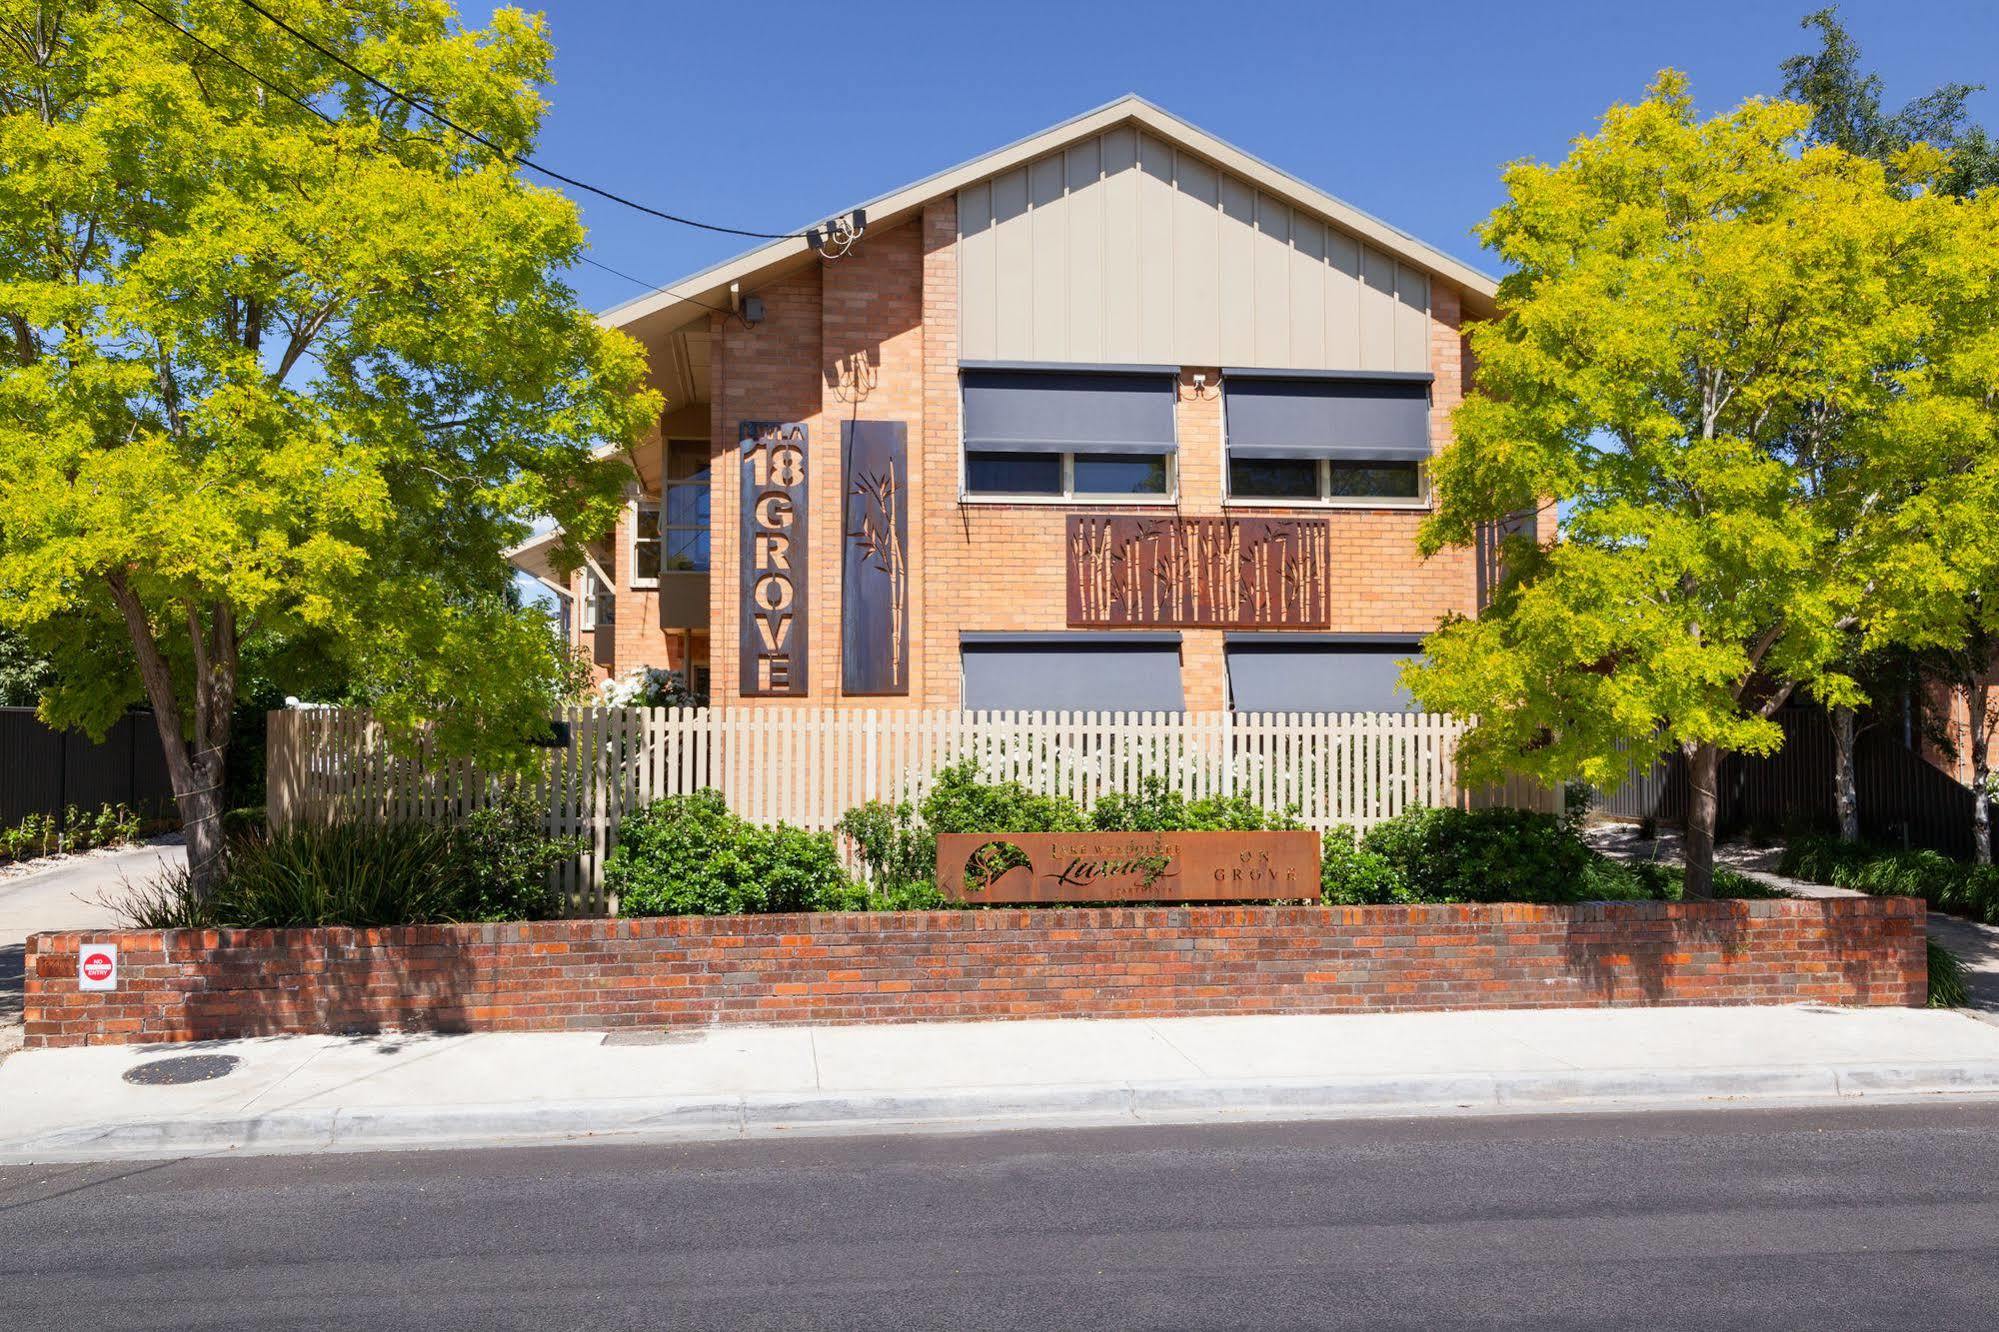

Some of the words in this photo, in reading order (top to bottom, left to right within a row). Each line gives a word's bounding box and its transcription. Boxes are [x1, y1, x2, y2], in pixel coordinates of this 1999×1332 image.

[743, 443, 806, 488] 18
[753, 490, 795, 691] GROVE
[1239, 848, 1272, 863] ON
[1214, 868, 1297, 881] GROVE
